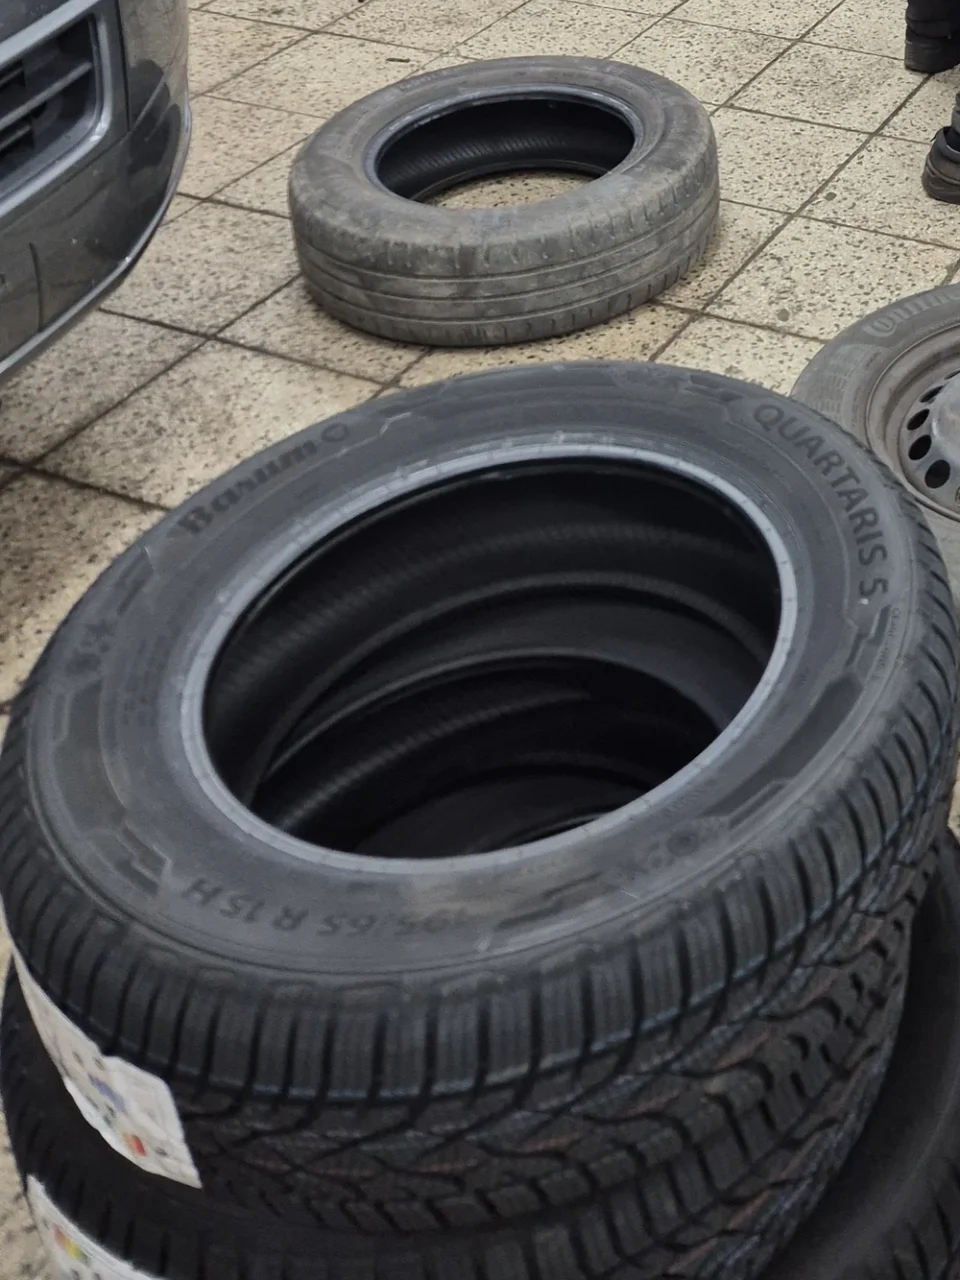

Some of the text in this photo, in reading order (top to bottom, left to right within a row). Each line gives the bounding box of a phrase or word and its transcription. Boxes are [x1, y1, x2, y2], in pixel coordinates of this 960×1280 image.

[170, 438, 318, 536] Barum
[752, 402, 890, 599] QUARTARIS 5
